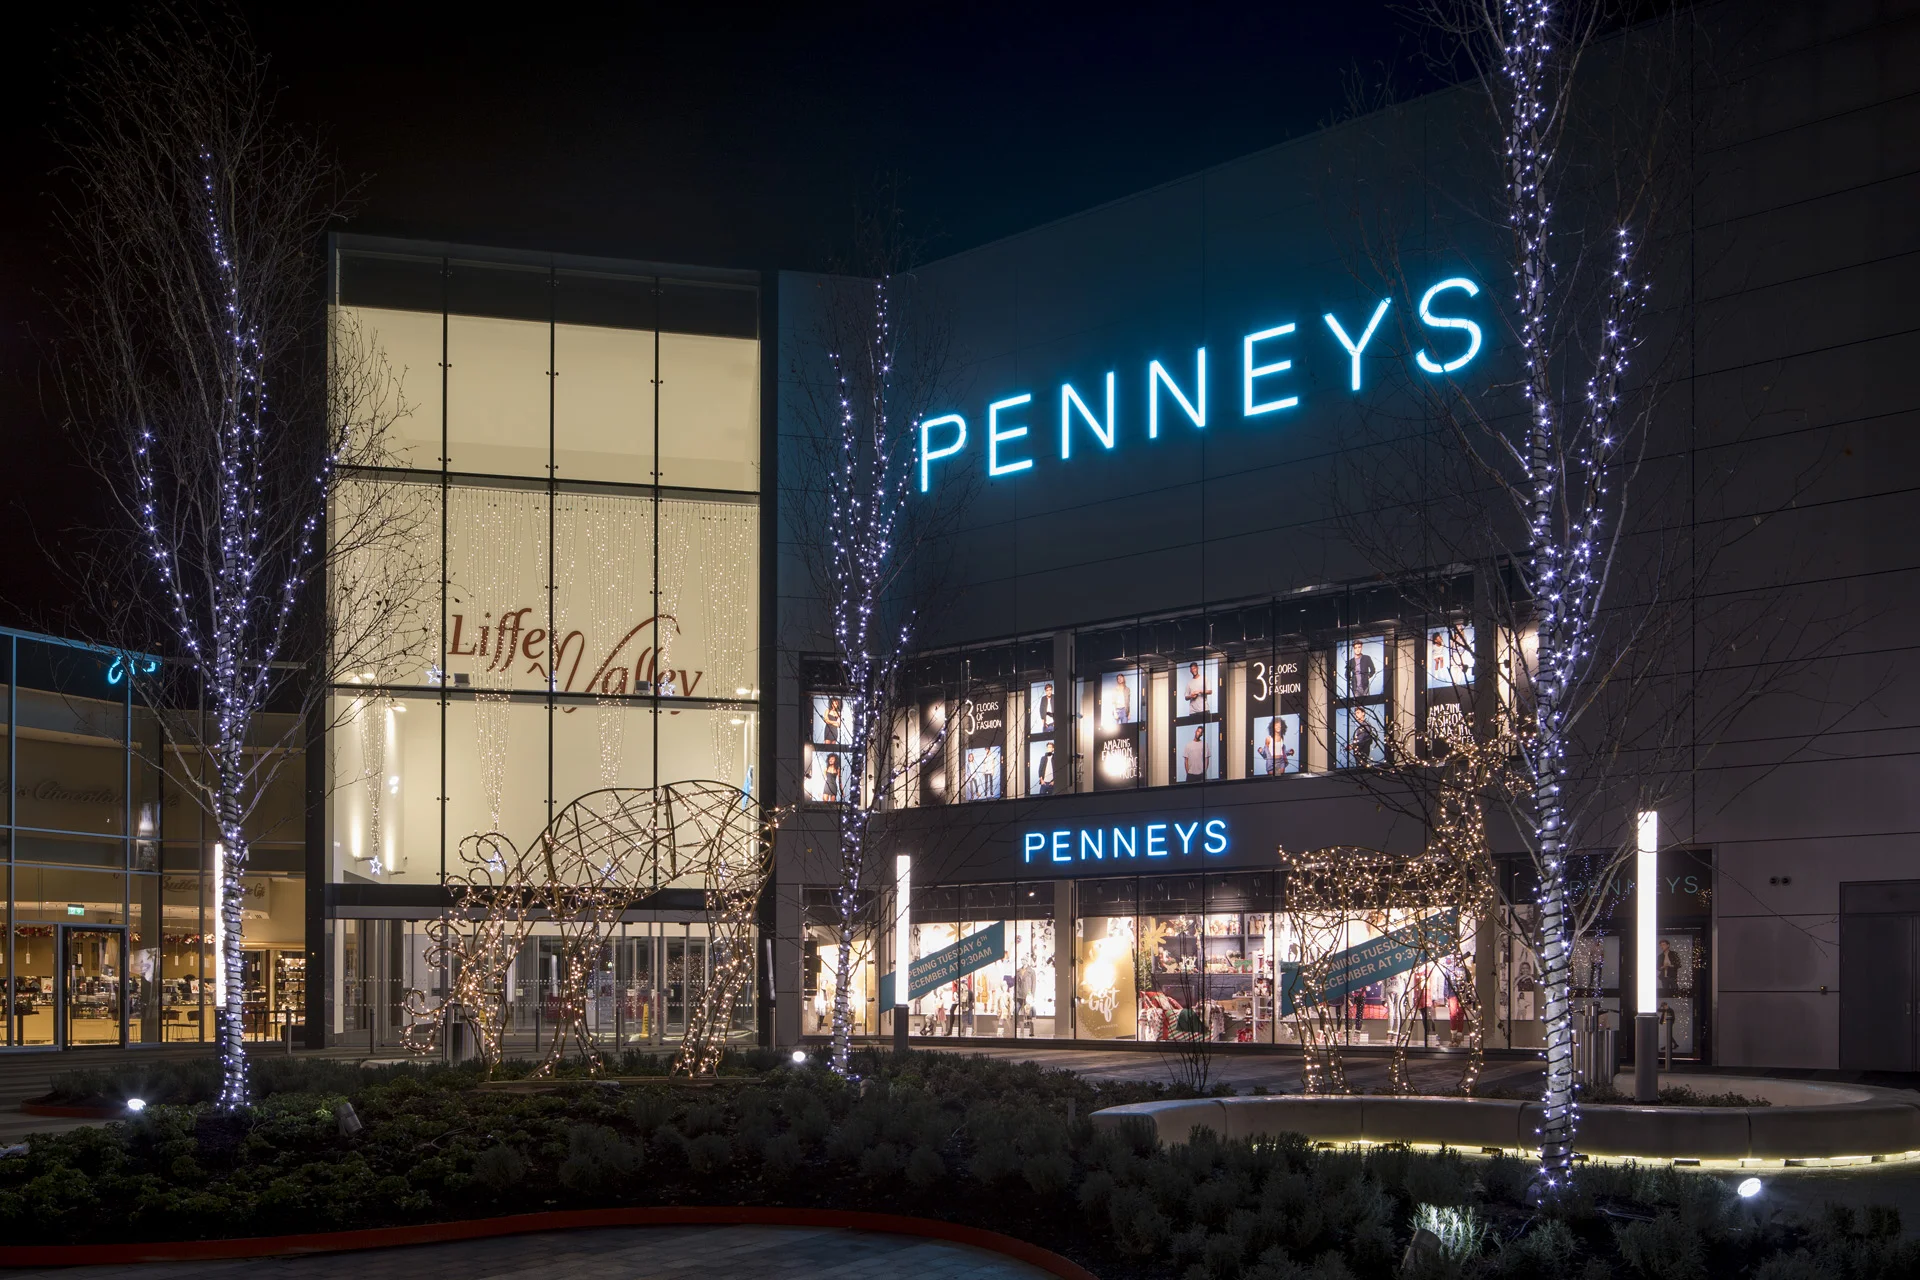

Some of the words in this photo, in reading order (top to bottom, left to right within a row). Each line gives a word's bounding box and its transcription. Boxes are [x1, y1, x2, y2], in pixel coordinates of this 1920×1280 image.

[919, 276, 1484, 494] PENNEYS
[446, 607, 562, 679] Liffey
[556, 613, 703, 715] Valley
[1253, 661, 1268, 702] 3
[1268, 674, 1280, 686] OF
[1268, 683, 1301, 696] FASHION
[964, 699, 976, 735] 3
[976, 701, 999, 712] FLOORS
[976, 711, 985, 721] OF
[976, 719, 1002, 730] FASHION
[1103, 738, 1131, 750] AMAZING
[1024, 819, 1228, 863] PENNEYS
[1569, 875, 1699, 896] PENNYS
[907, 967, 948, 993] DECEMBER
[949, 962, 959, 973] AT
[960, 946, 993, 967] 9:30AM
[908, 959, 937, 979] PENING
[937, 941, 974, 964] TUESDAY
[1378, 956, 1393, 971] AT
[1088, 987, 1121, 1023] Gift
